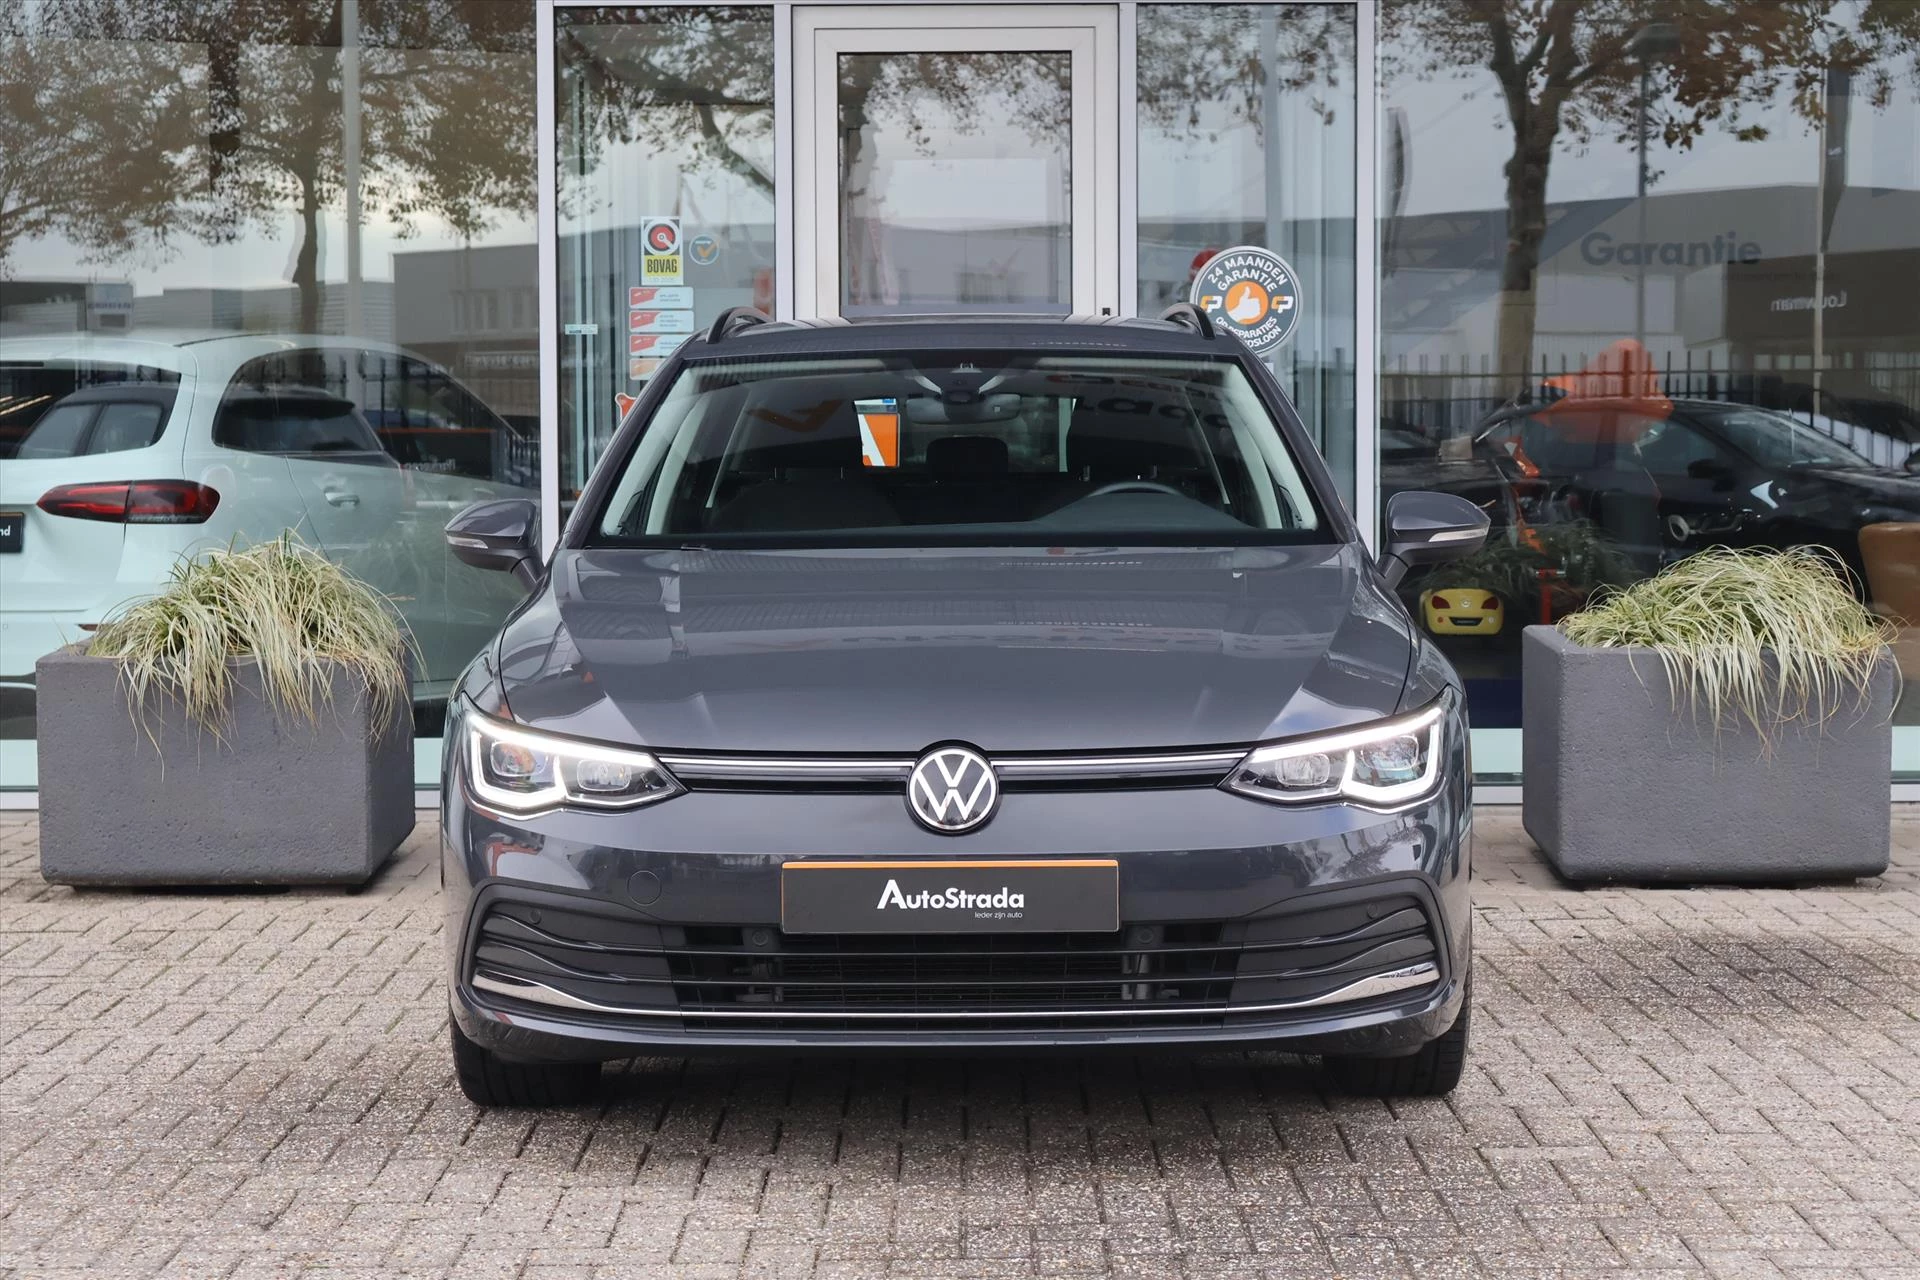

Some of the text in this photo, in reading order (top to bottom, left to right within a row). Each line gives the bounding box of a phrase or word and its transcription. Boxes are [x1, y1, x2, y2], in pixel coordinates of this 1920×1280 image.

[1580, 231, 1762, 266] Garantie
[647, 258, 678, 273] BOVAG
[1208, 256, 1288, 285] 24 MAANDEN
[1217, 268, 1278, 293] GARANTIE
[877, 879, 1025, 909] AutoStrada
[994, 911, 1006, 920] zijn
[1007, 911, 1023, 919] auto
